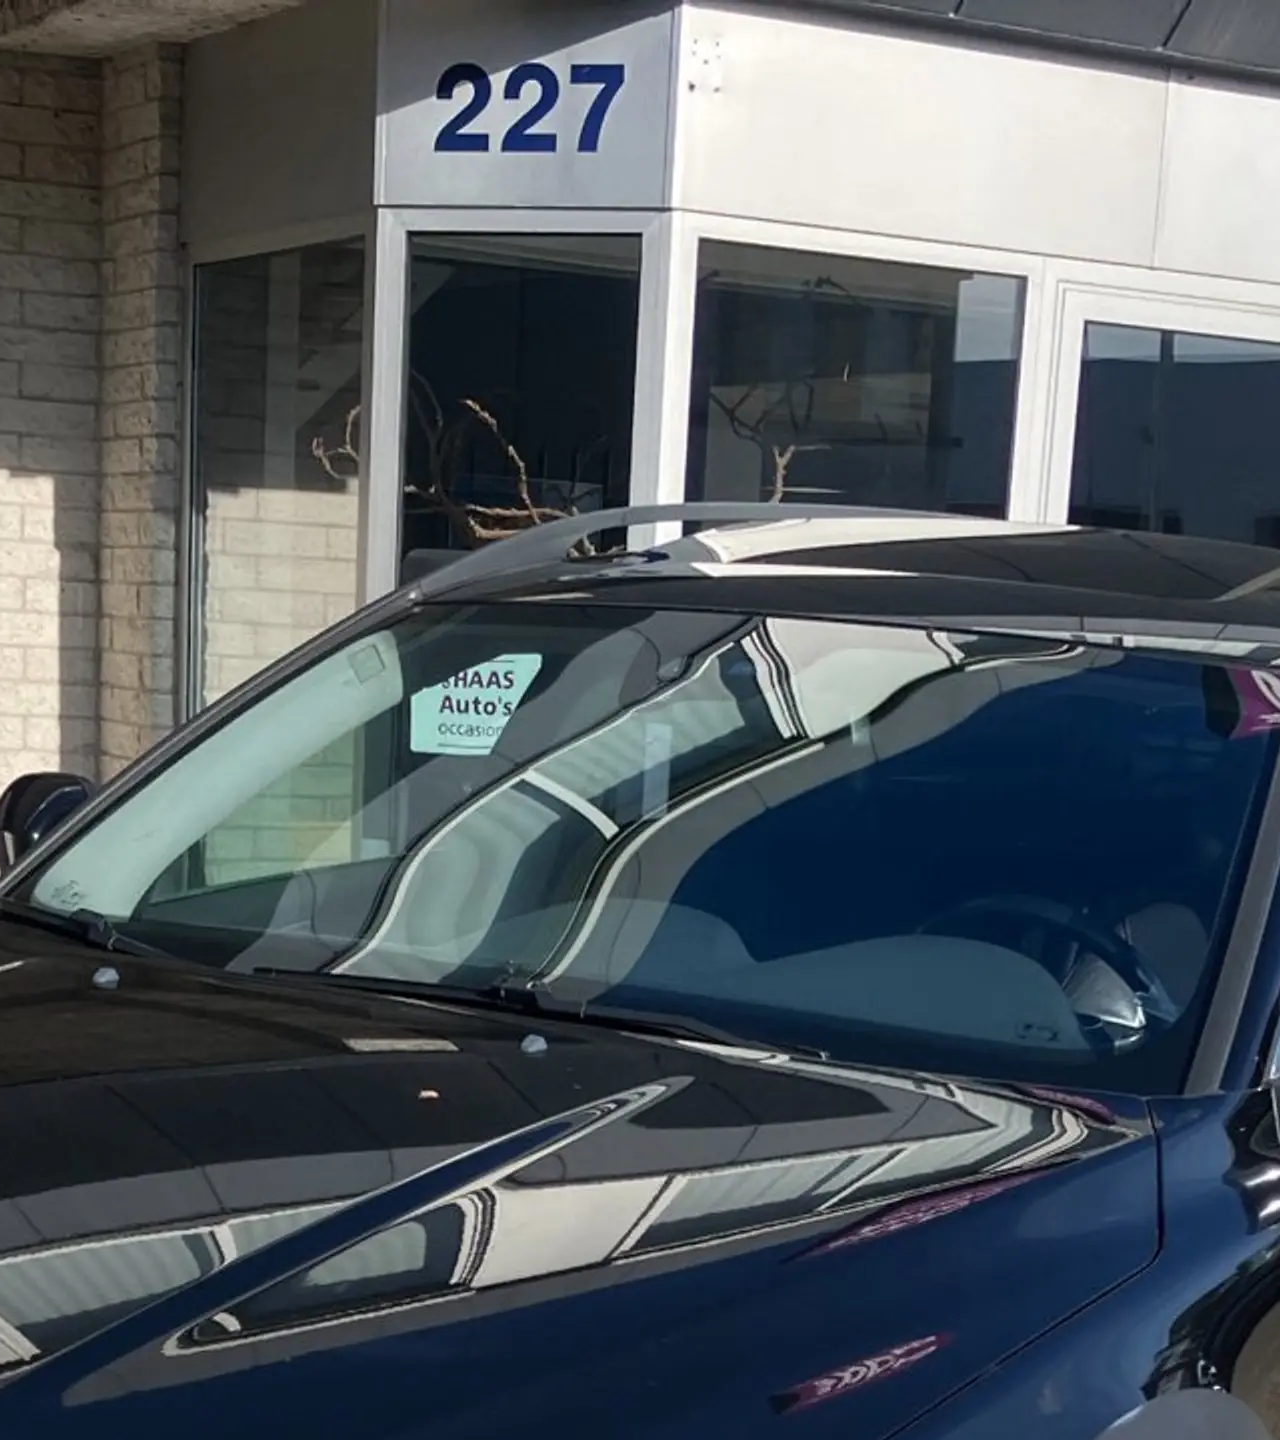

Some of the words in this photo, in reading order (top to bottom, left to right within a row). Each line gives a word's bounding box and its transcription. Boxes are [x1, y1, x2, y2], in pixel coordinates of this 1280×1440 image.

[433, 62, 625, 153] 227
[454, 671, 514, 689] HAAS
[439, 695, 514, 716] Auto's
[438, 722, 504, 738] occasion
